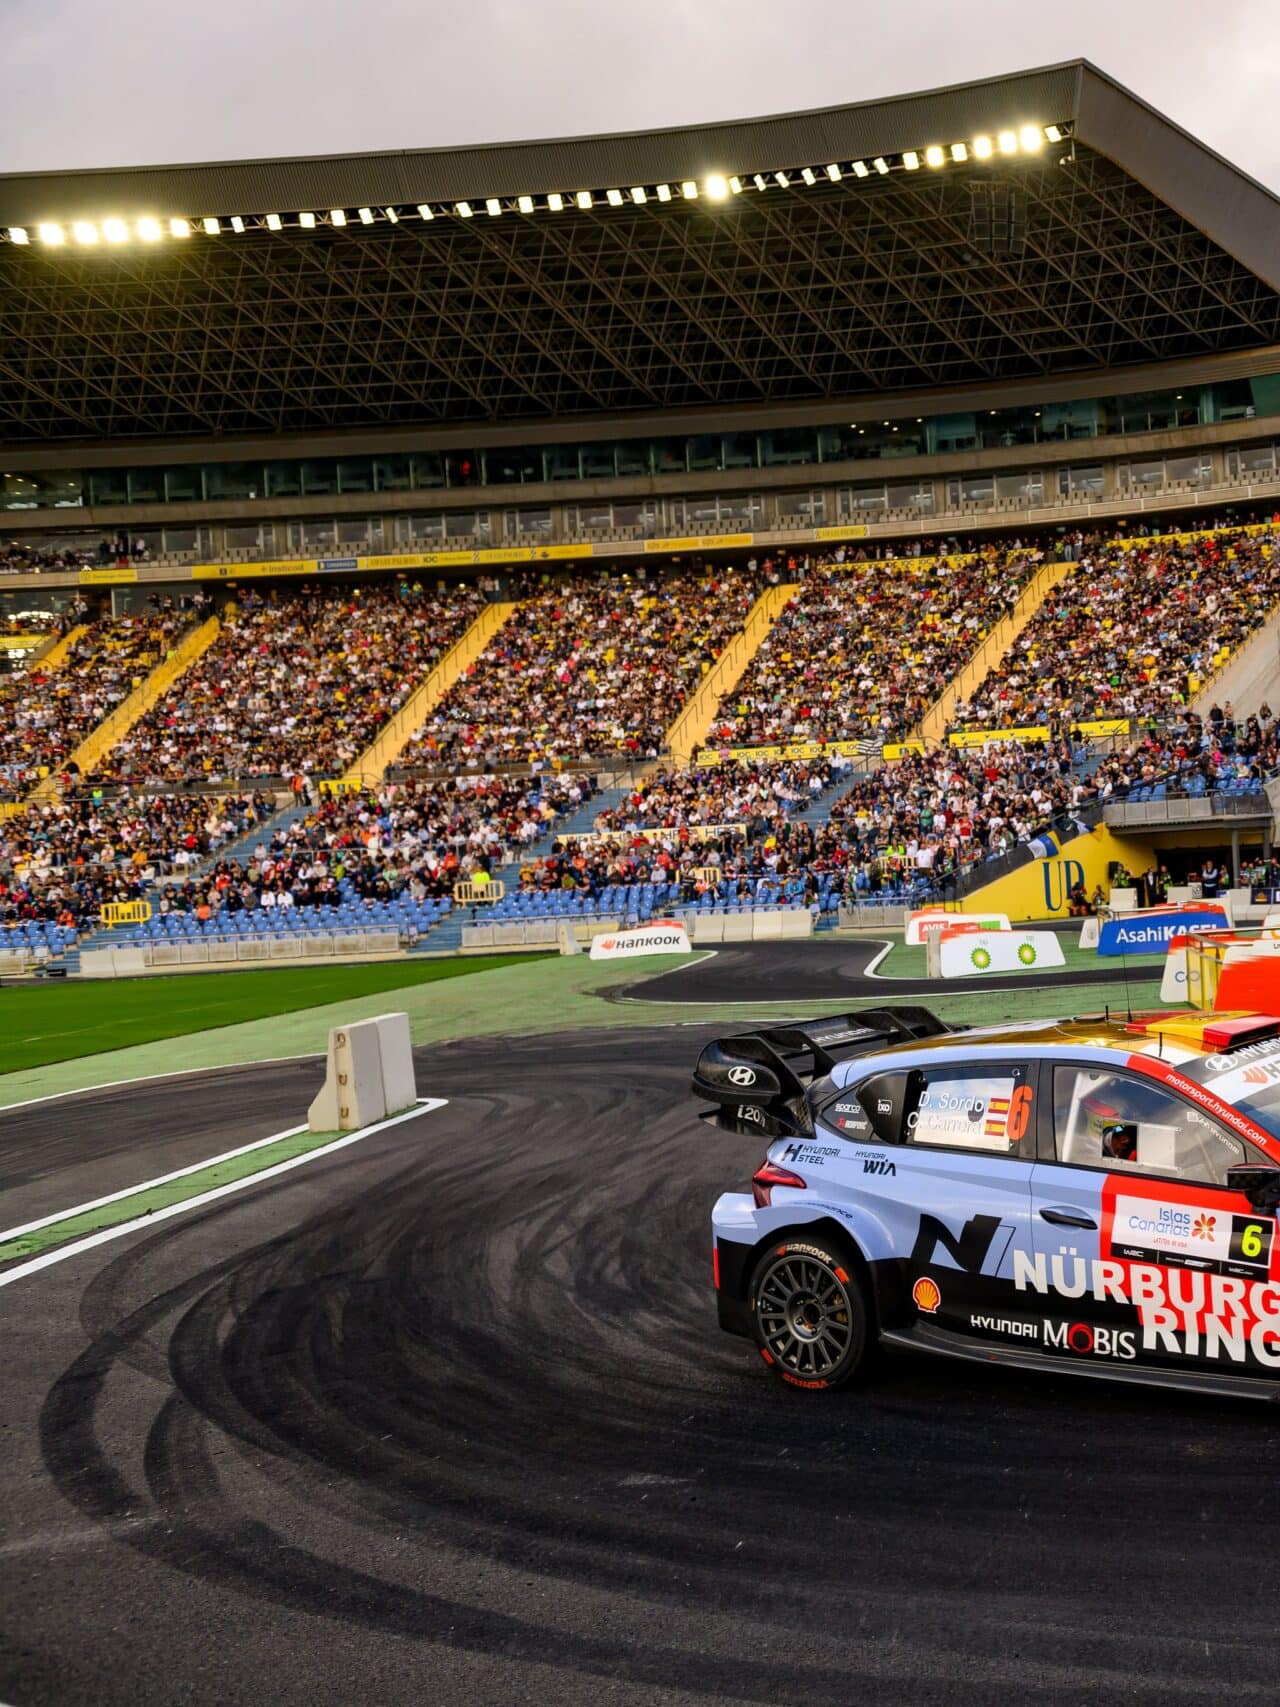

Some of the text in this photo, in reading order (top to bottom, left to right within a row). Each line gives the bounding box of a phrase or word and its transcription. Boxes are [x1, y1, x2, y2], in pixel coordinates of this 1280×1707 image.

[1042, 860, 1085, 911] UD
[616, 936, 681, 949] Hankook
[918, 1091, 984, 1112] D. Sordo
[1007, 1084, 1033, 1140] 6
[1166, 1073, 1268, 1146] motorsport.hyundai.com
[797, 1154, 825, 1165] STEEL
[801, 1146, 841, 1157] HYUNDAI
[855, 1150, 886, 1159] HYUNDAI
[1128, 1215, 1190, 1238] Canarias
[1160, 1208, 1191, 1225] Islas
[1241, 1224, 1263, 1257] 6
[971, 1315, 1038, 1339] HYUNDAI
[1043, 1319, 1136, 1360] MOBIS
